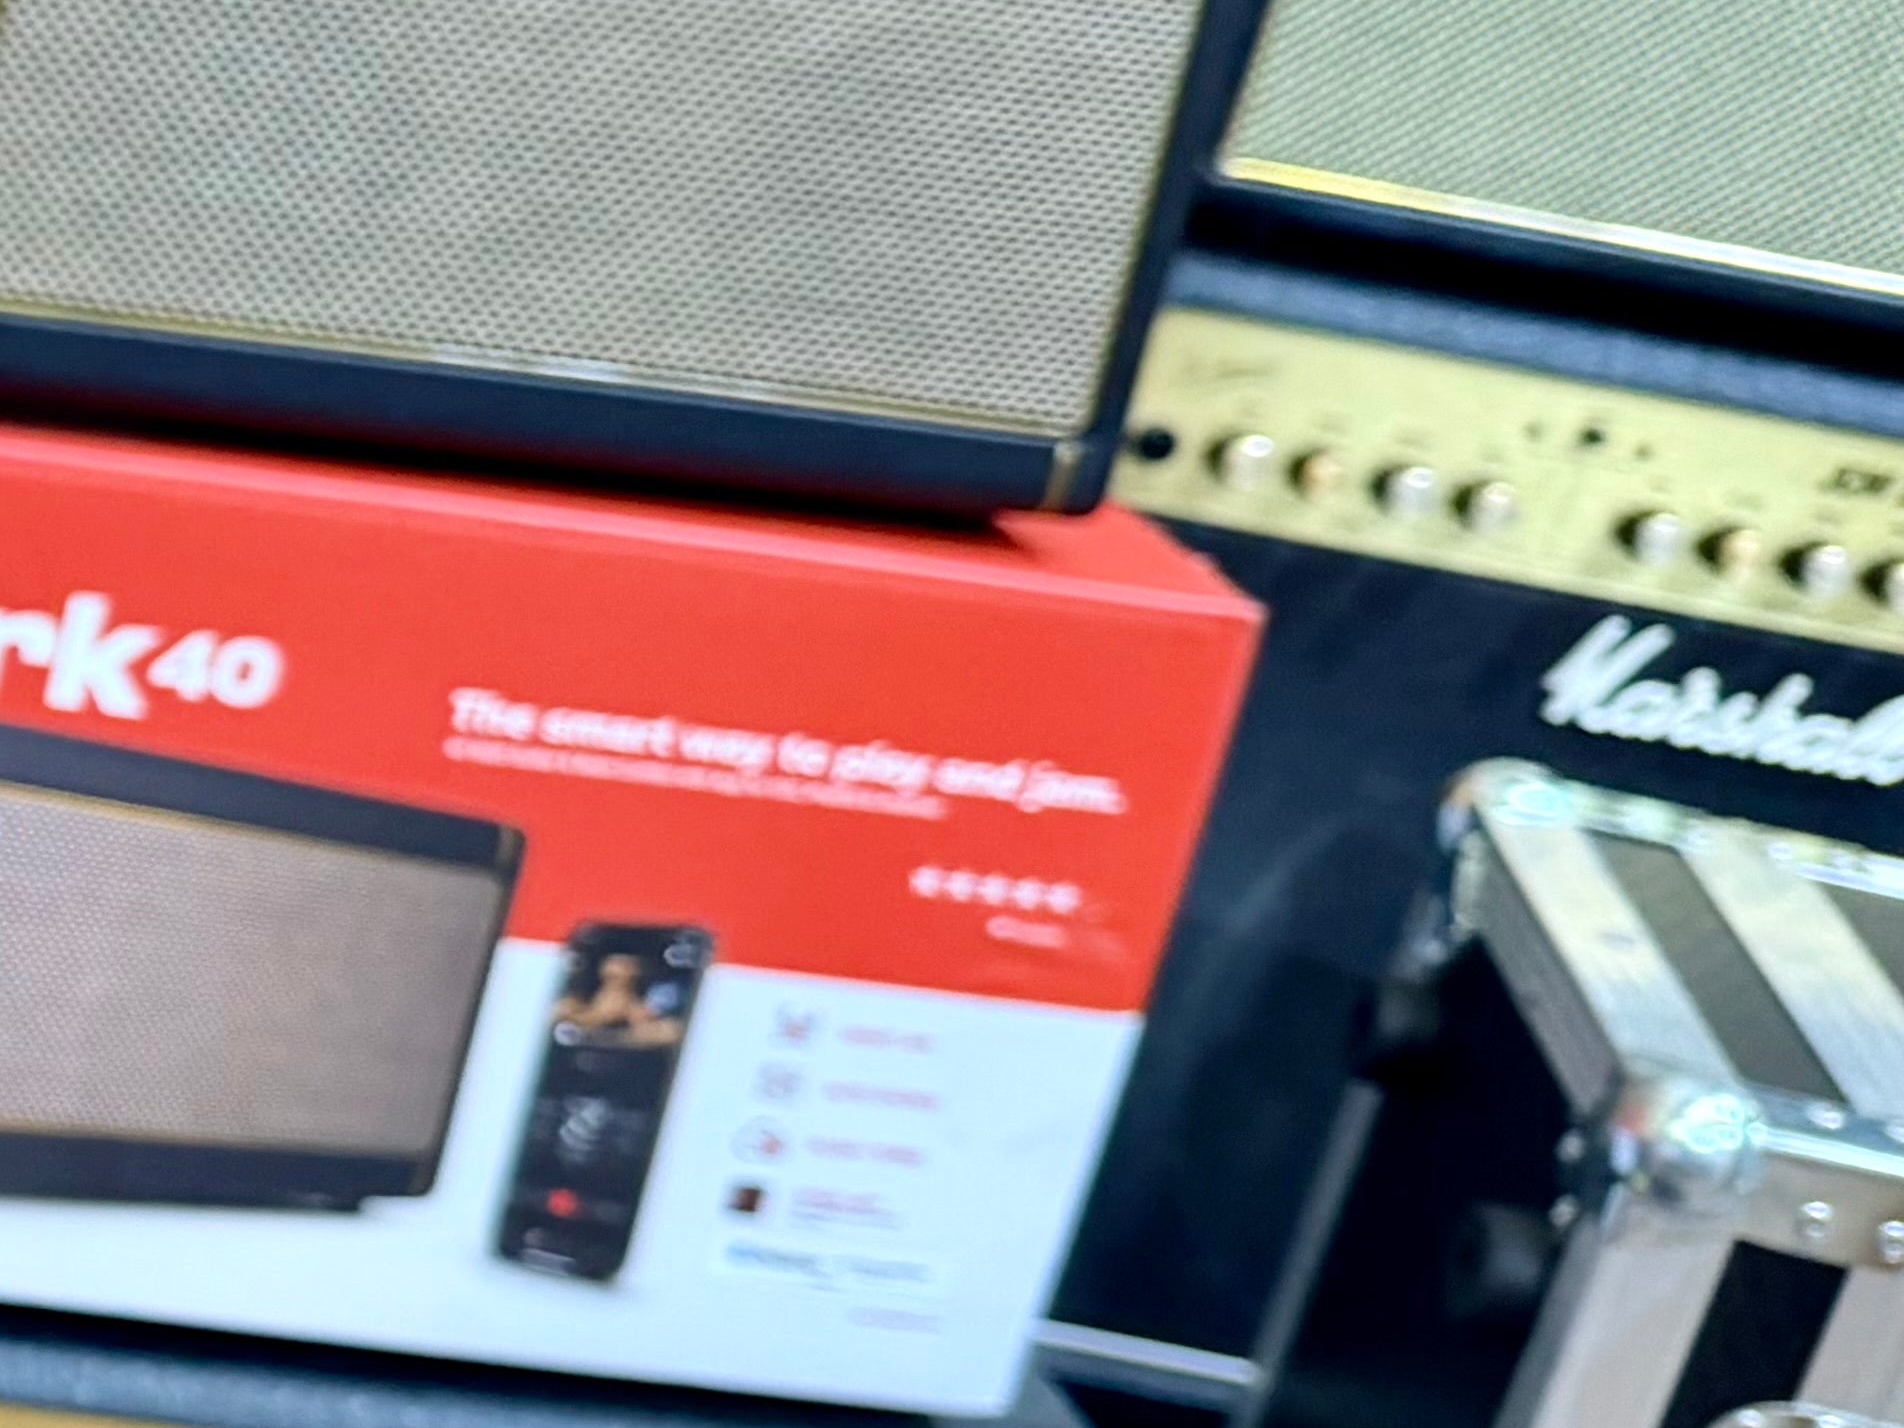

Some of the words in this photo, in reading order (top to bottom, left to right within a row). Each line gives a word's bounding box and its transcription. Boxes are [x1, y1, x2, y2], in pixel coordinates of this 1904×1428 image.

[146, 630, 284, 710] 40
[450, 686, 537, 741] The
[539, 705, 678, 758] smart
